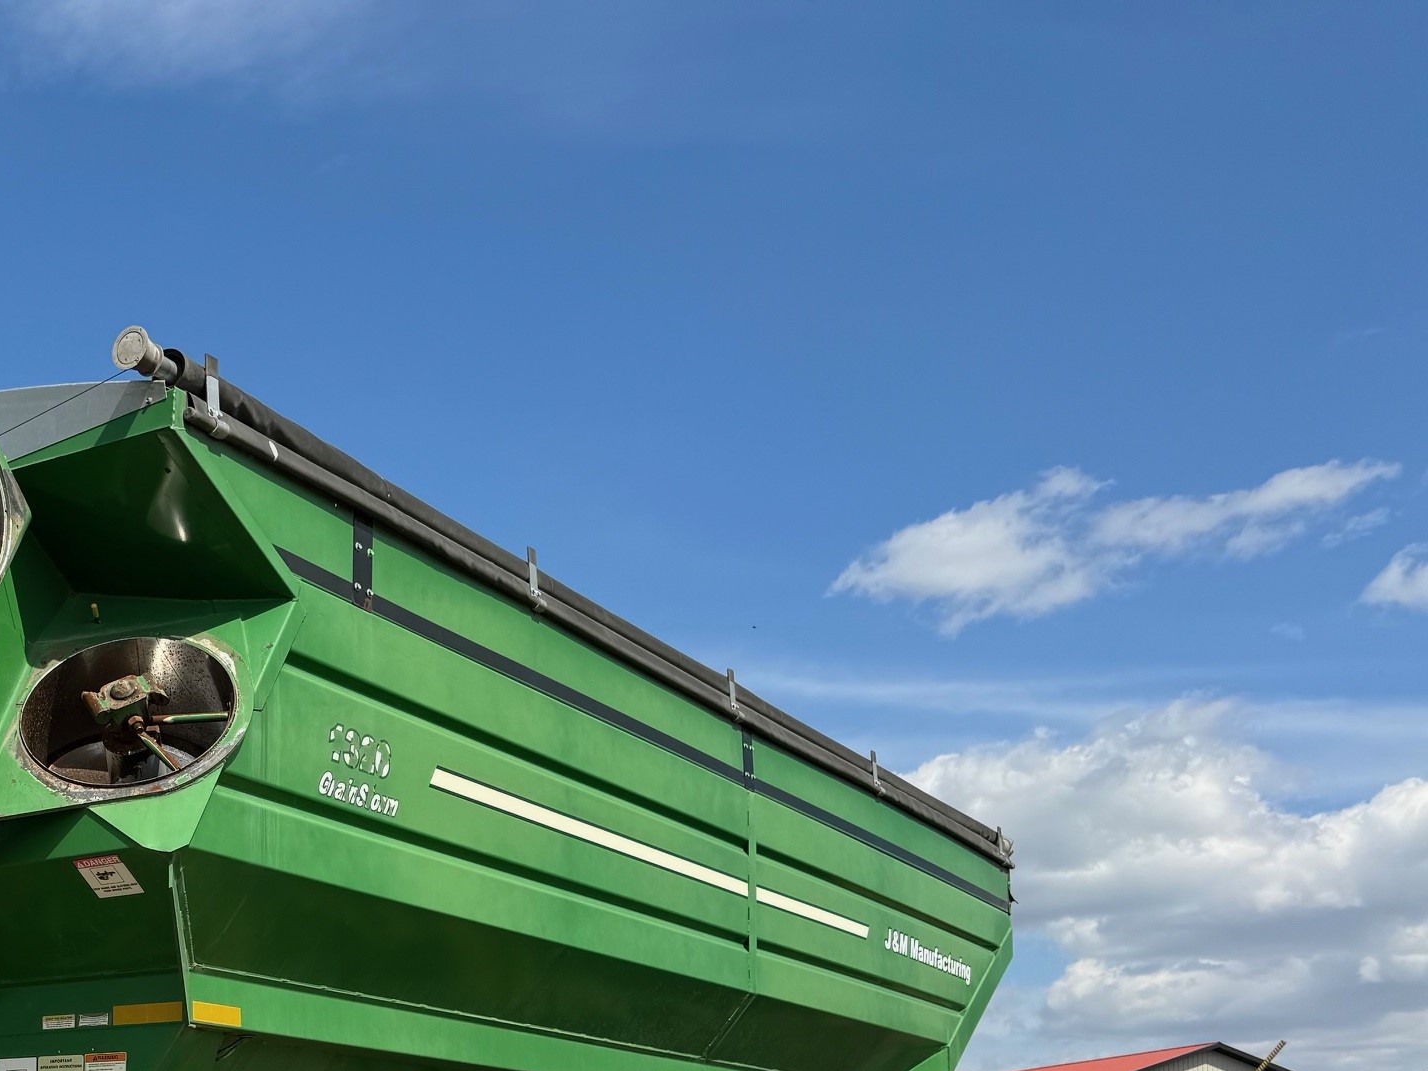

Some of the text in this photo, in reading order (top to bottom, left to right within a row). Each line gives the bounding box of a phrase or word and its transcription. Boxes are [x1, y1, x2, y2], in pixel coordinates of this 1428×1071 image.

[83, 856, 121, 867] DANGER
[884, 927, 972, 986] J&M Manufacturing
